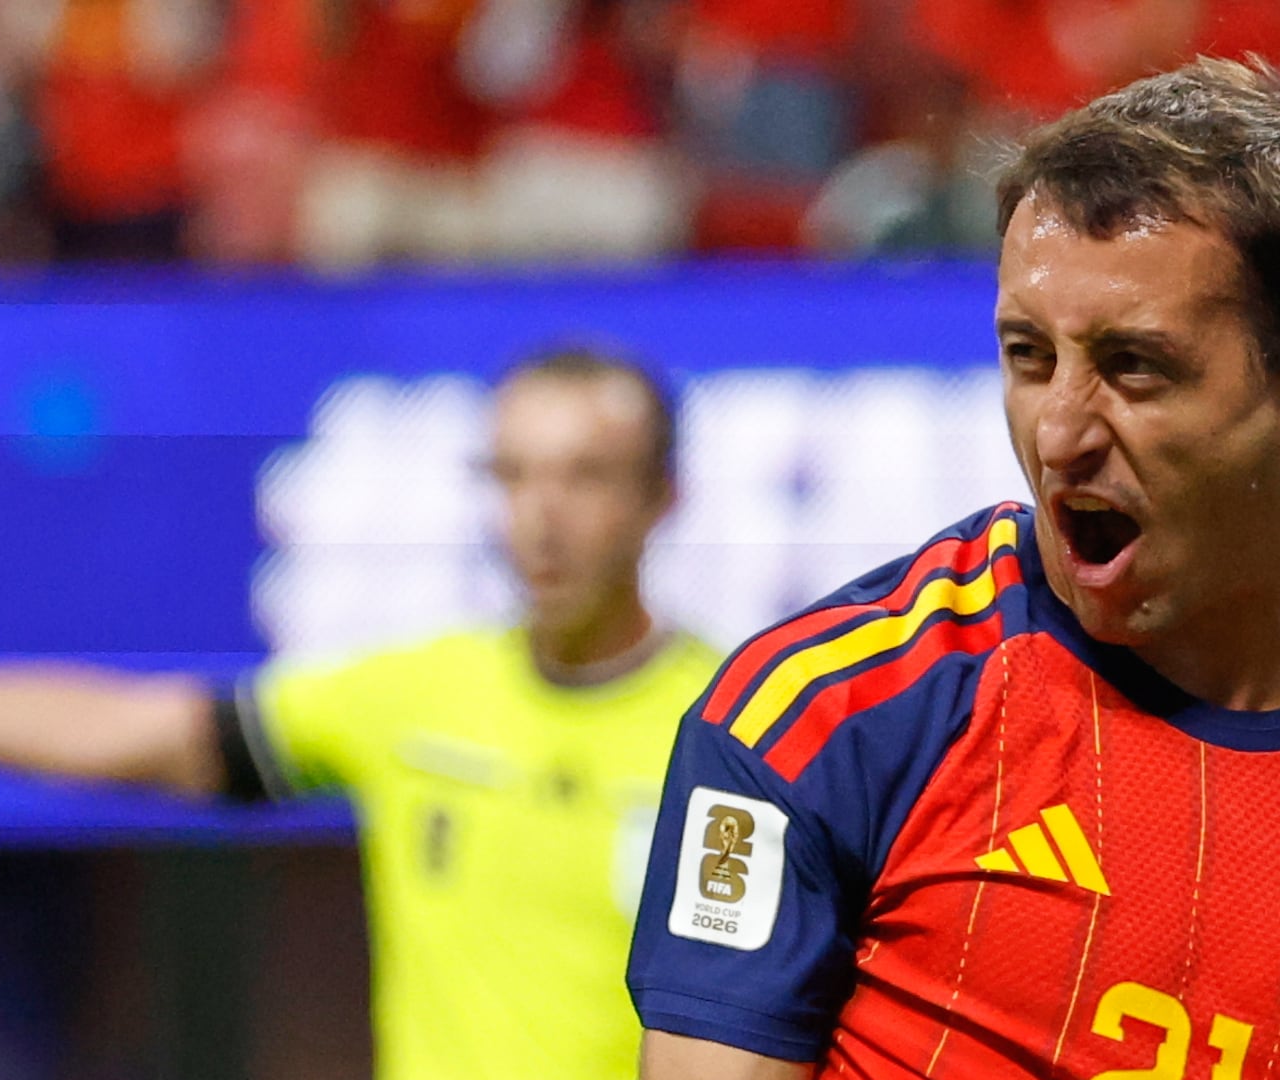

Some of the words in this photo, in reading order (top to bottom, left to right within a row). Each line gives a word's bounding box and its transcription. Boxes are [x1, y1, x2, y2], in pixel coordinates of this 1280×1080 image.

[706, 880, 732, 897] FIFA
[694, 902, 721, 915] WORLD
[722, 908, 742, 919] CUP
[691, 913, 738, 934] 2026
